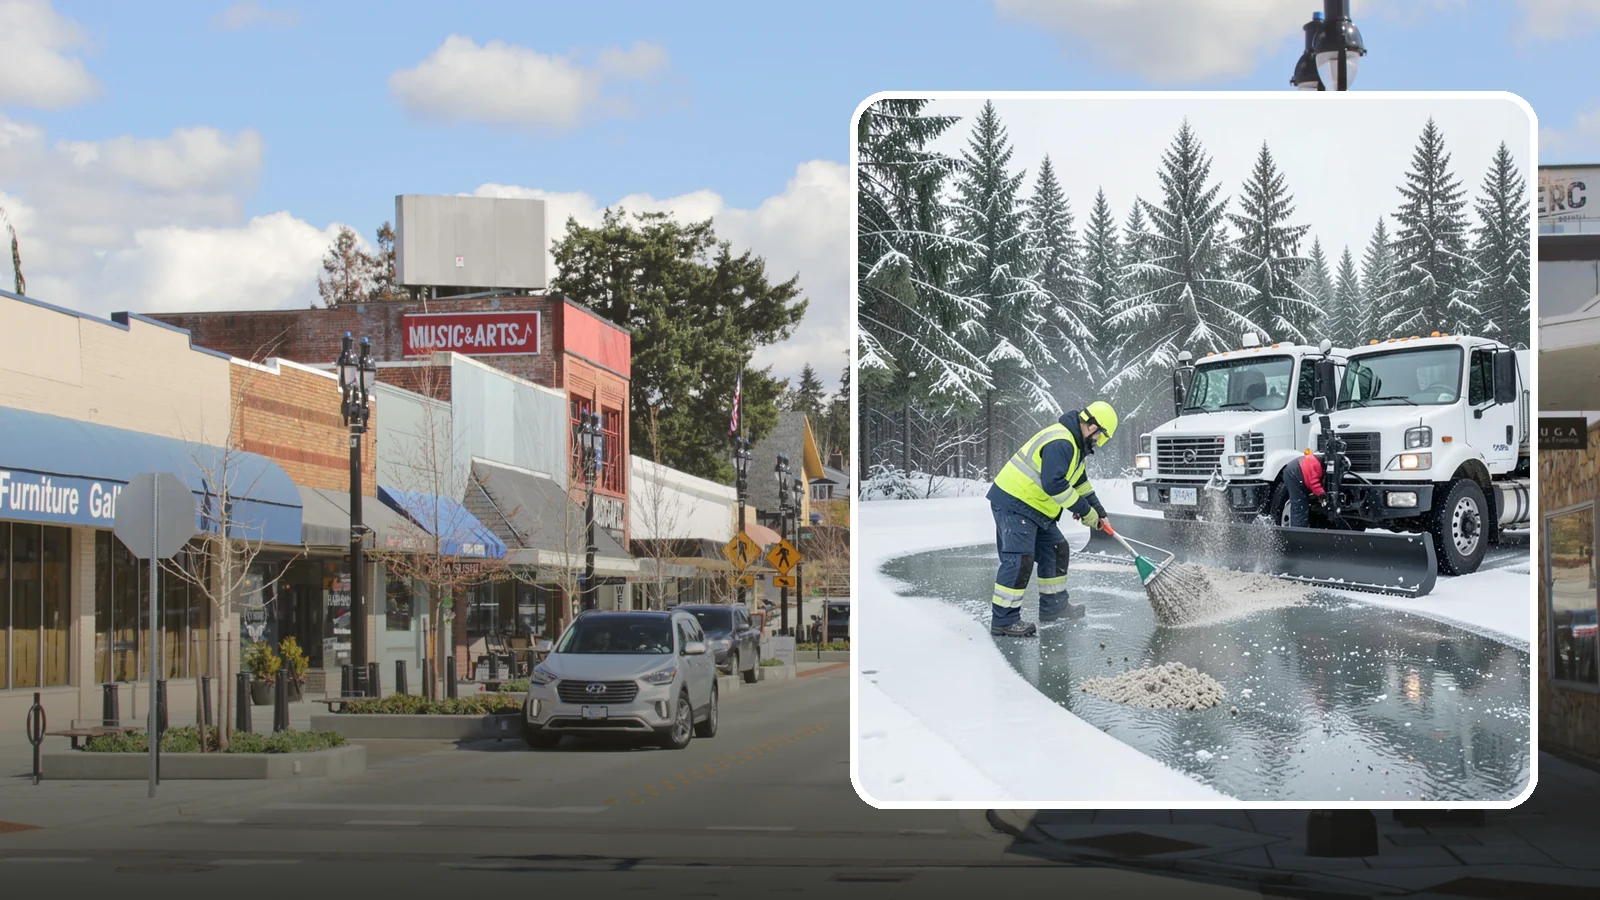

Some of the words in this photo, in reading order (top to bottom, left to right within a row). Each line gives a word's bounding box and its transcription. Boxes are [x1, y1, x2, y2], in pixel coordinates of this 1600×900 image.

[409, 323, 519, 349] MUSIC&ARTS
[1541, 428, 1577, 436] UGA
[0, 471, 79, 515] Furniture
[89, 482, 121, 519] Gal
[453, 563, 479, 573] SUSHI
